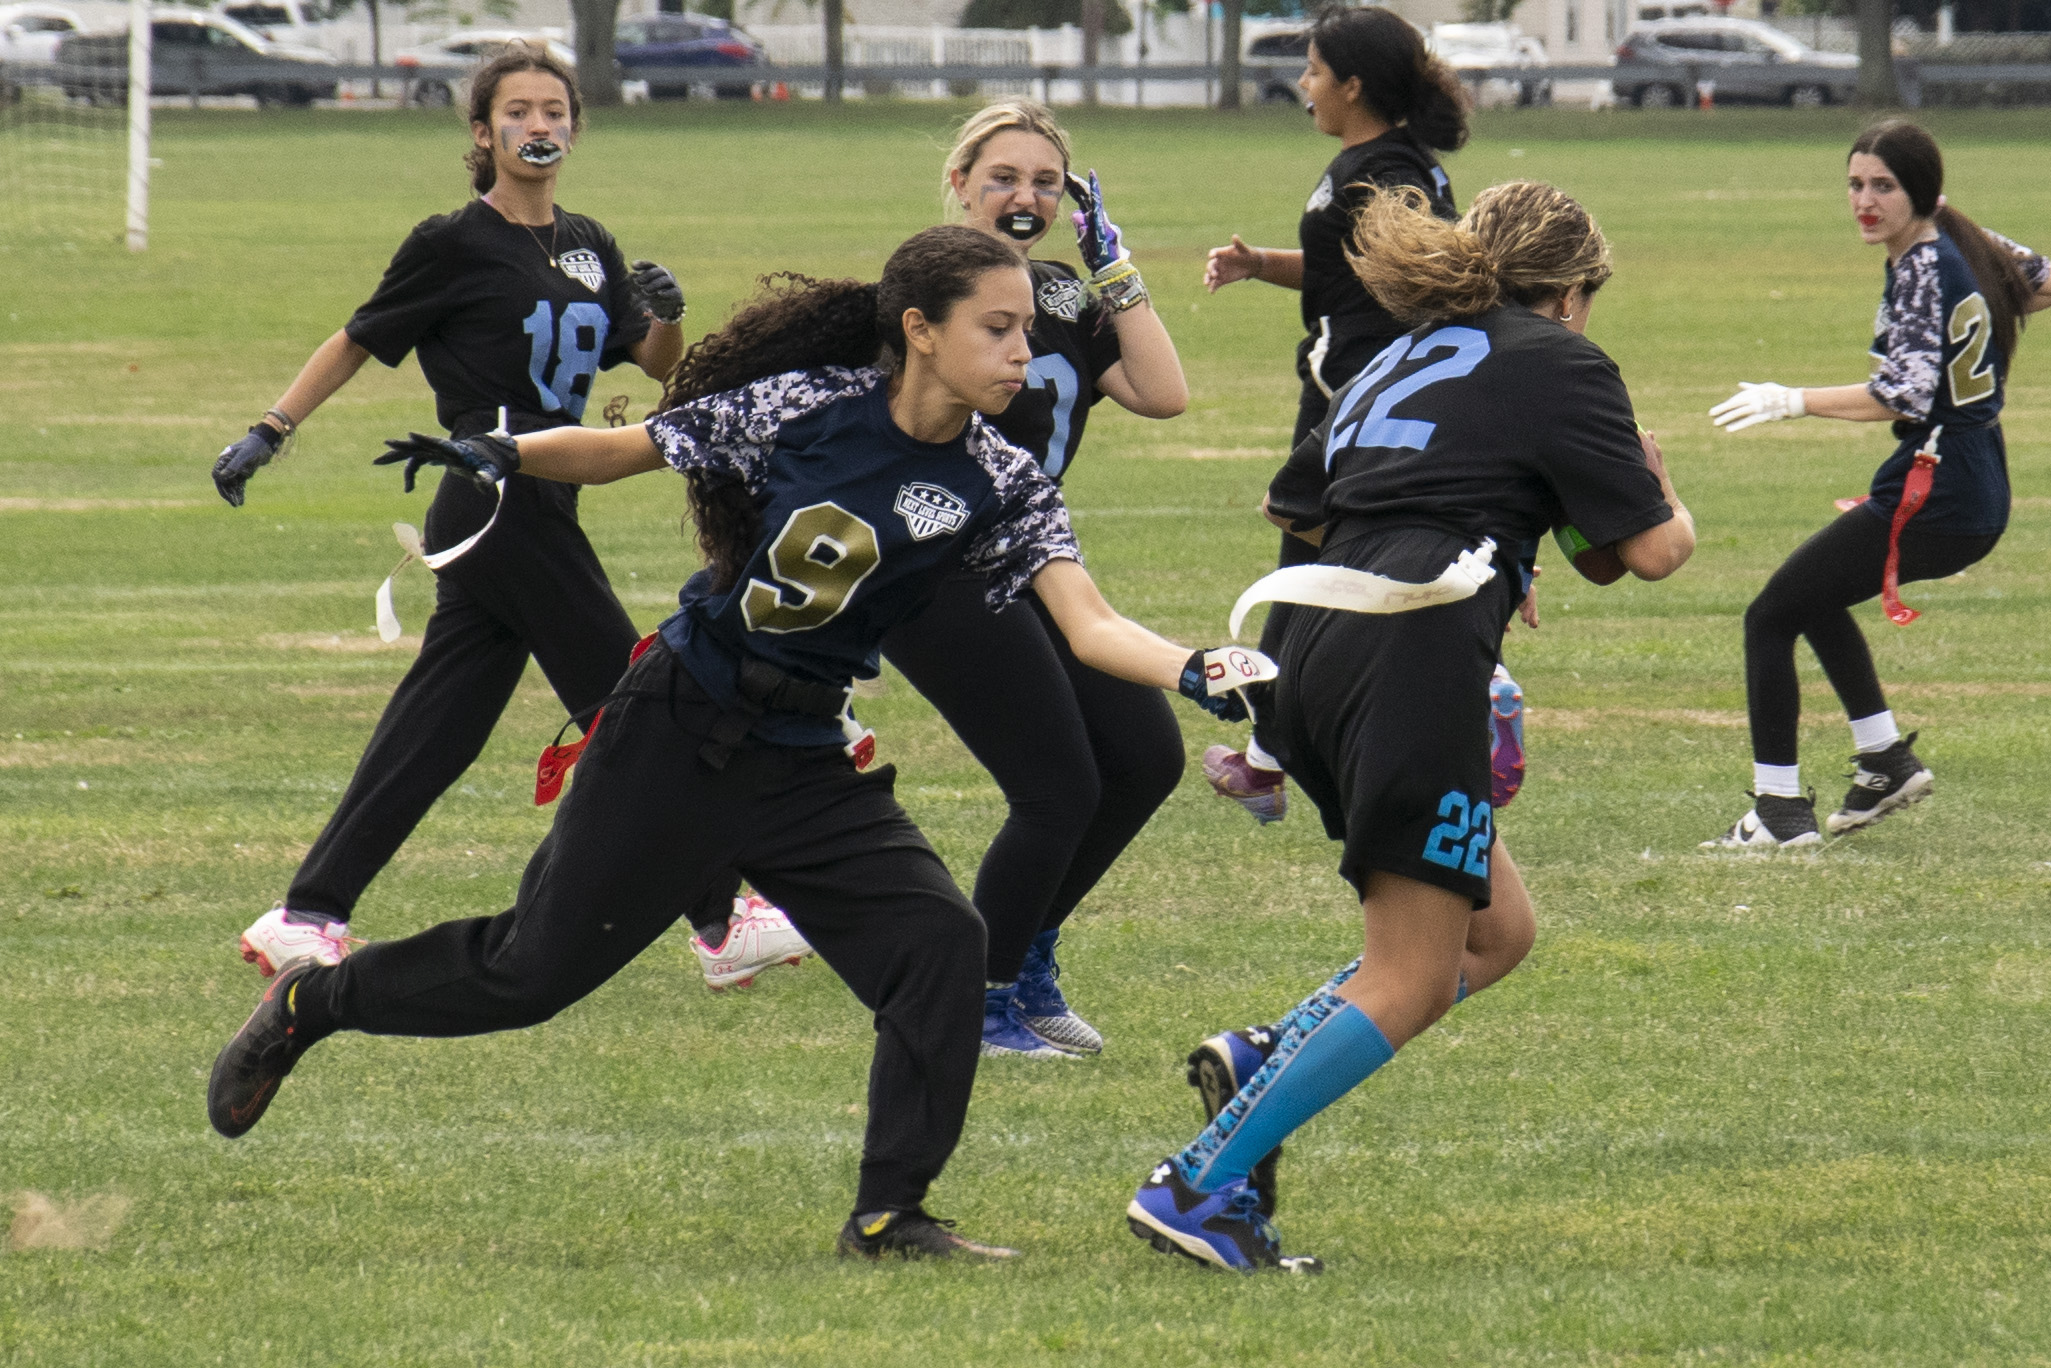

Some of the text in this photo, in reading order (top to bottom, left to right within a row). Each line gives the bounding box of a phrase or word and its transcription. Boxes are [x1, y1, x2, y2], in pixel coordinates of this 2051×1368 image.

[523, 300, 611, 420] 18
[1324, 325, 1492, 474] 22
[1947, 291, 1997, 407] 2
[740, 501, 881, 635] 9
[901, 497, 958, 526] NEXT LEVEL SPORTS
[1422, 790, 1491, 878] 22
